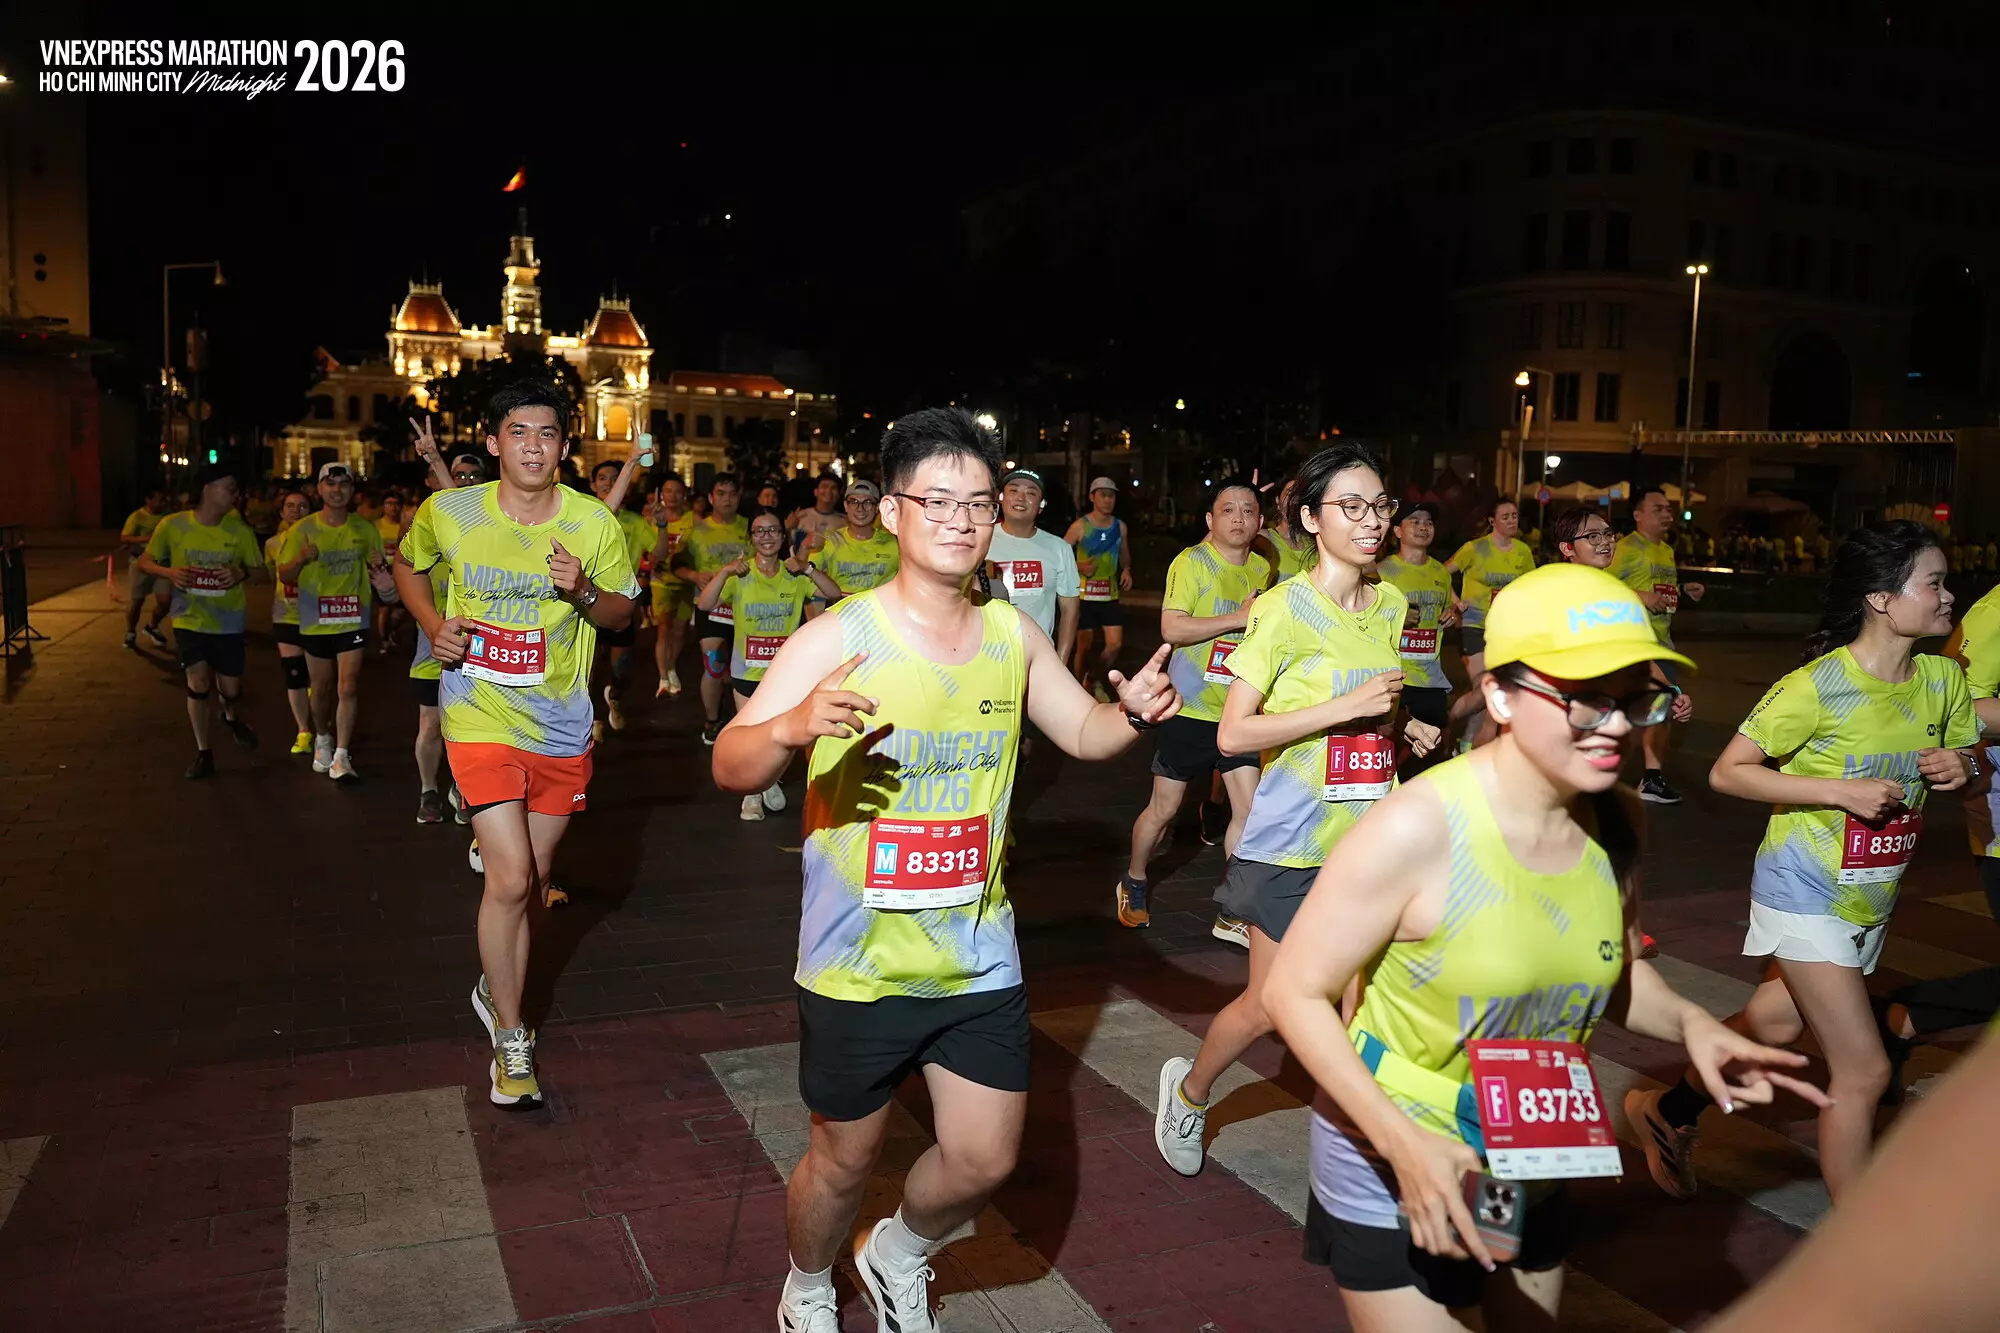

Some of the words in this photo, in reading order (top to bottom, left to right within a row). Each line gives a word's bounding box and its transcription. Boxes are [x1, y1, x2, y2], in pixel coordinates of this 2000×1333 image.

[463, 562, 554, 599] MIDNIGH
[1012, 573, 1039, 583] 1247
[330, 605, 358, 614] 82434
[482, 597, 540, 626] 2026
[471, 638, 483, 655] M
[488, 645, 539, 665] 83312
[1409, 639, 1435, 649] 83855
[866, 725, 1008, 769] MIDNIGHT
[1348, 749, 1393, 770] 83314
[1842, 750, 1921, 780] MIDNI
[895, 771, 971, 813] 2026
[1853, 834, 1862, 853] F
[1869, 832, 1917, 855] 83310
[876, 847, 895, 871] M
[906, 847, 980, 874] 83313
[1458, 982, 1612, 1040] MIDNIGH
[1489, 1085, 1503, 1120] F
[1518, 1087, 1601, 1123] 83733
